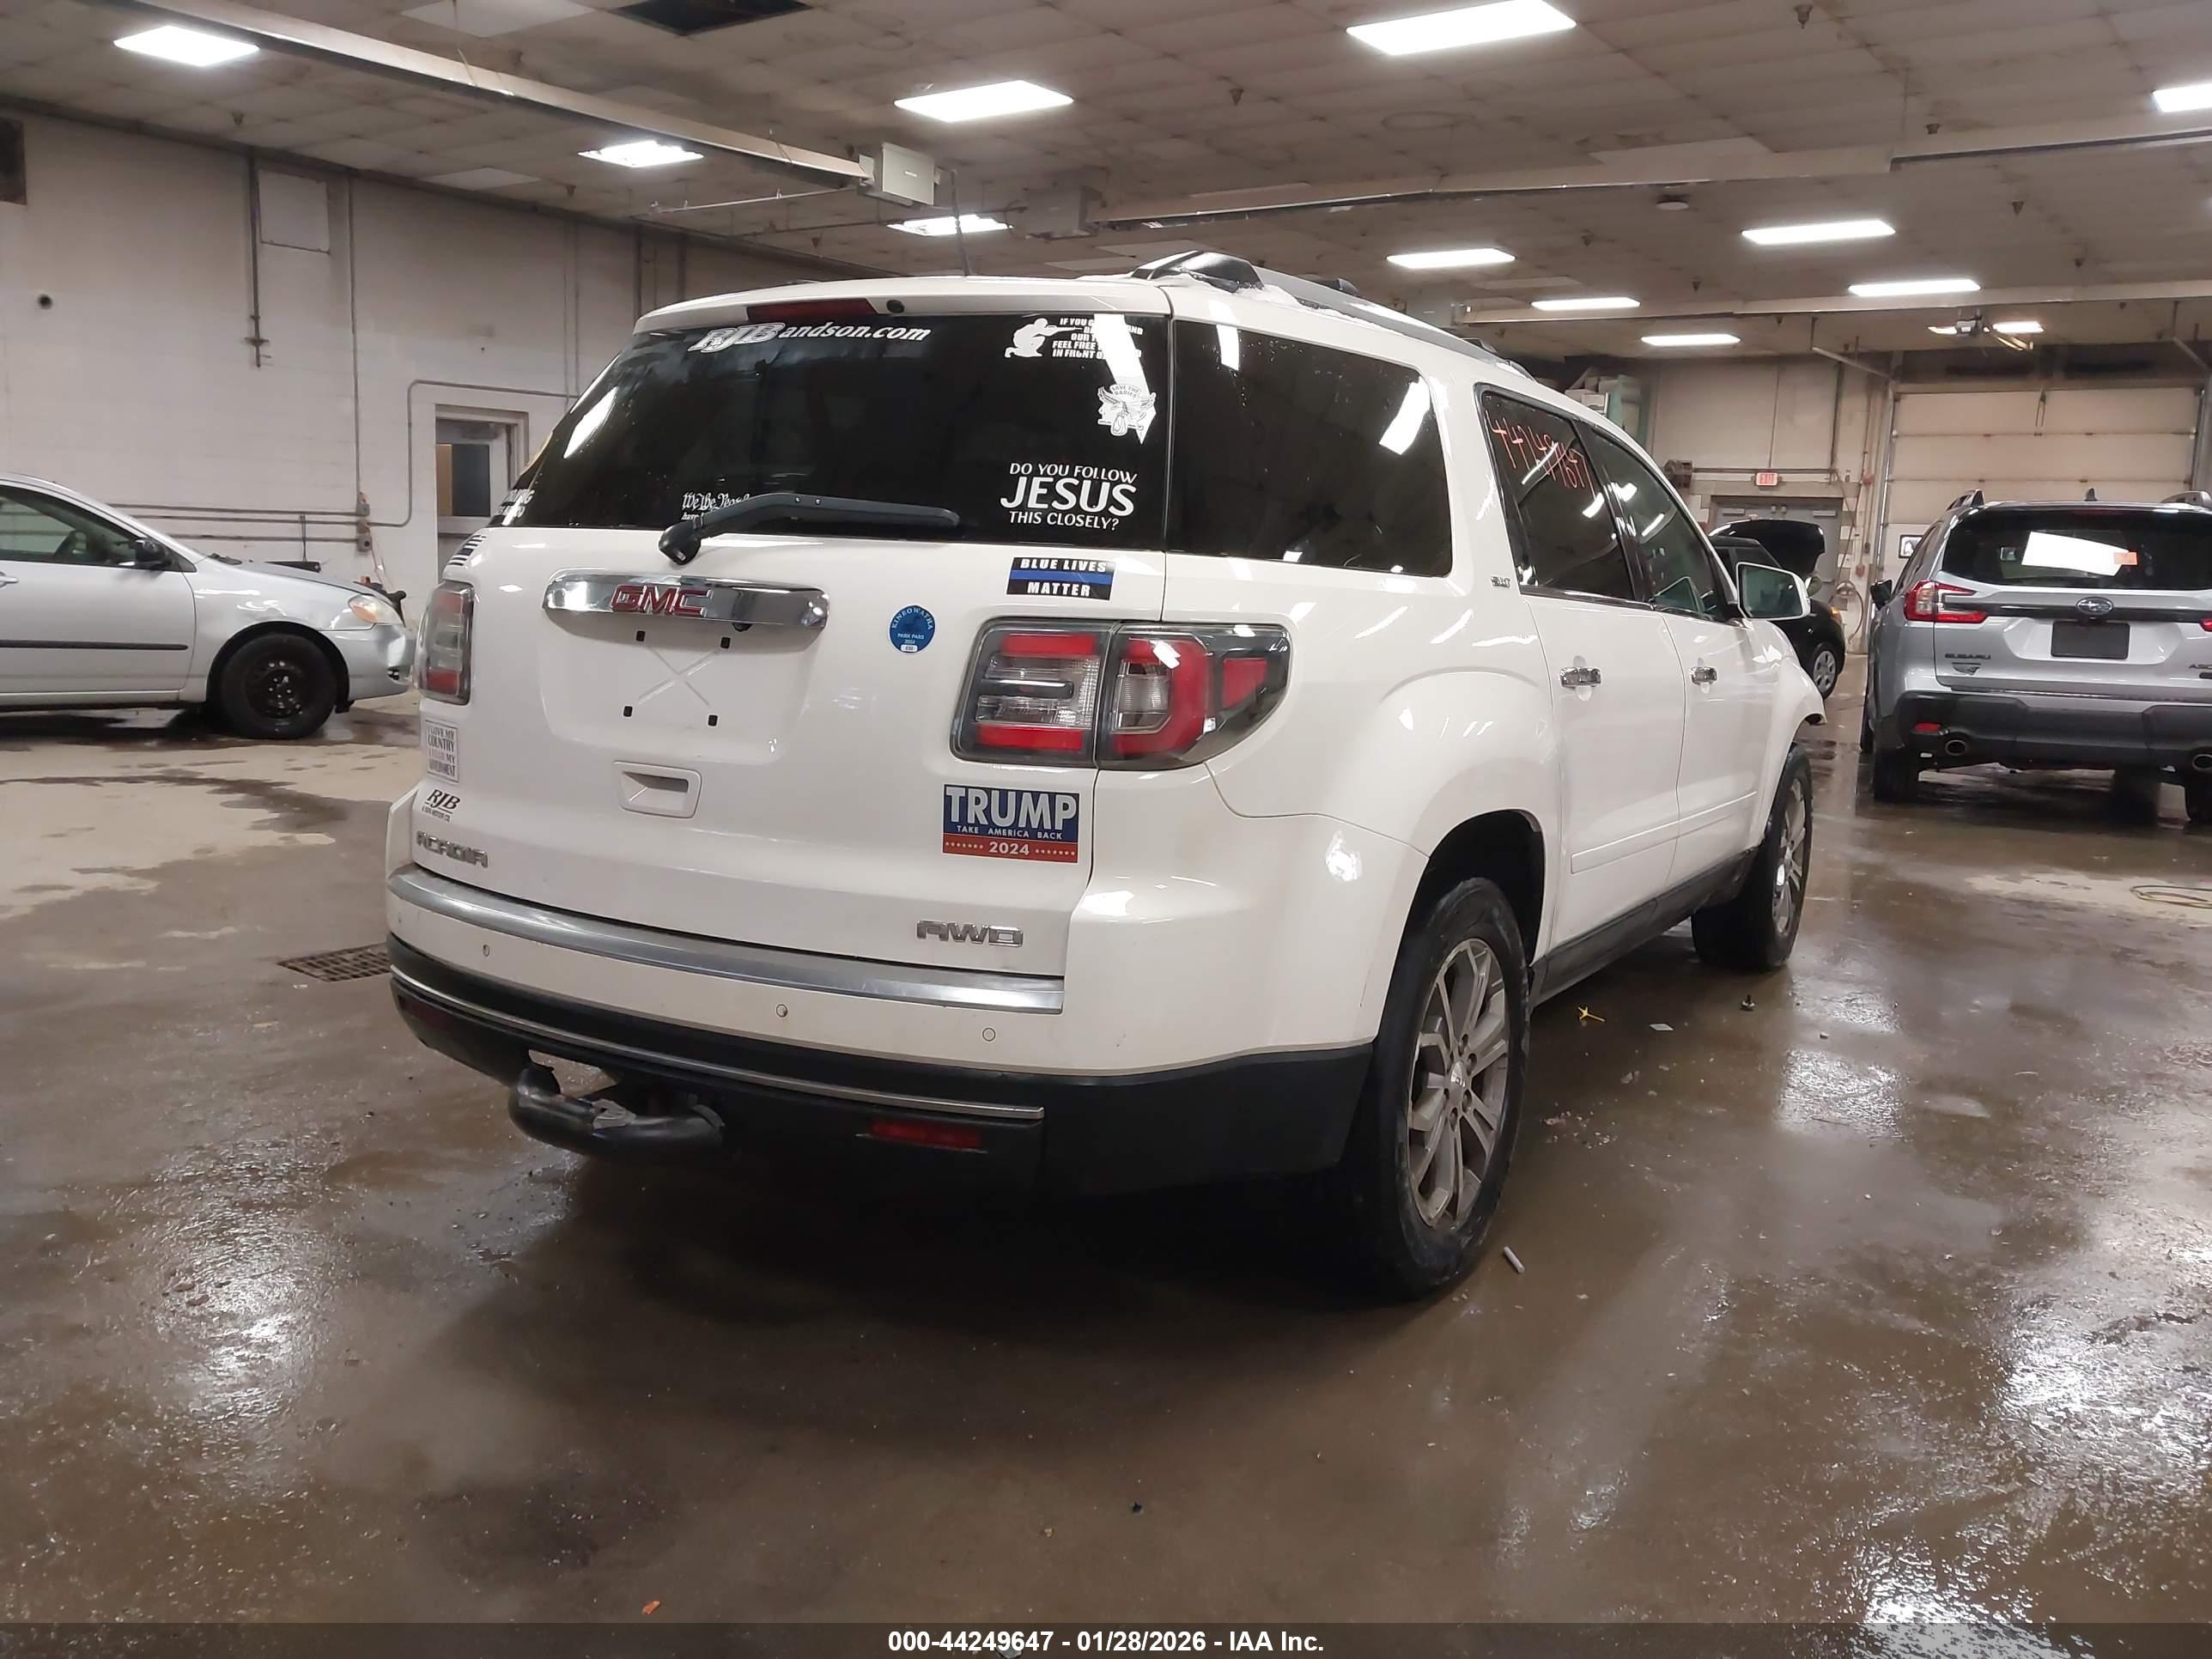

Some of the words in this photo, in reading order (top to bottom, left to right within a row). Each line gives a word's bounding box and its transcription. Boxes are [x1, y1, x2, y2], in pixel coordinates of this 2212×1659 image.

[1064, 349, 1095, 359] FRONT
[1073, 342, 1097, 350] FREE
[1009, 463, 1033, 475] DO
[1037, 464, 1070, 477] YOU
[1073, 465, 1137, 483] FOLLOW
[1000, 476, 1137, 517] JESUS
[1009, 511, 1042, 525] THIS
[1047, 513, 1120, 531] CLOSELY?
[1020, 558, 1058, 569] BLUE
[1062, 560, 1107, 573] LIVES
[1027, 582, 1091, 597] MATTER
[612, 585, 713, 617] GMC
[428, 734, 454, 753] COUNTRY
[427, 788, 461, 810] RJB
[945, 787, 1077, 830] TRUMP
[957, 825, 979, 834] TAKE
[988, 828, 1030, 838] AMERICA
[416, 830, 489, 868] ACADIA
[988, 842, 1030, 855] 2024
[917, 921, 1024, 947] AWD
